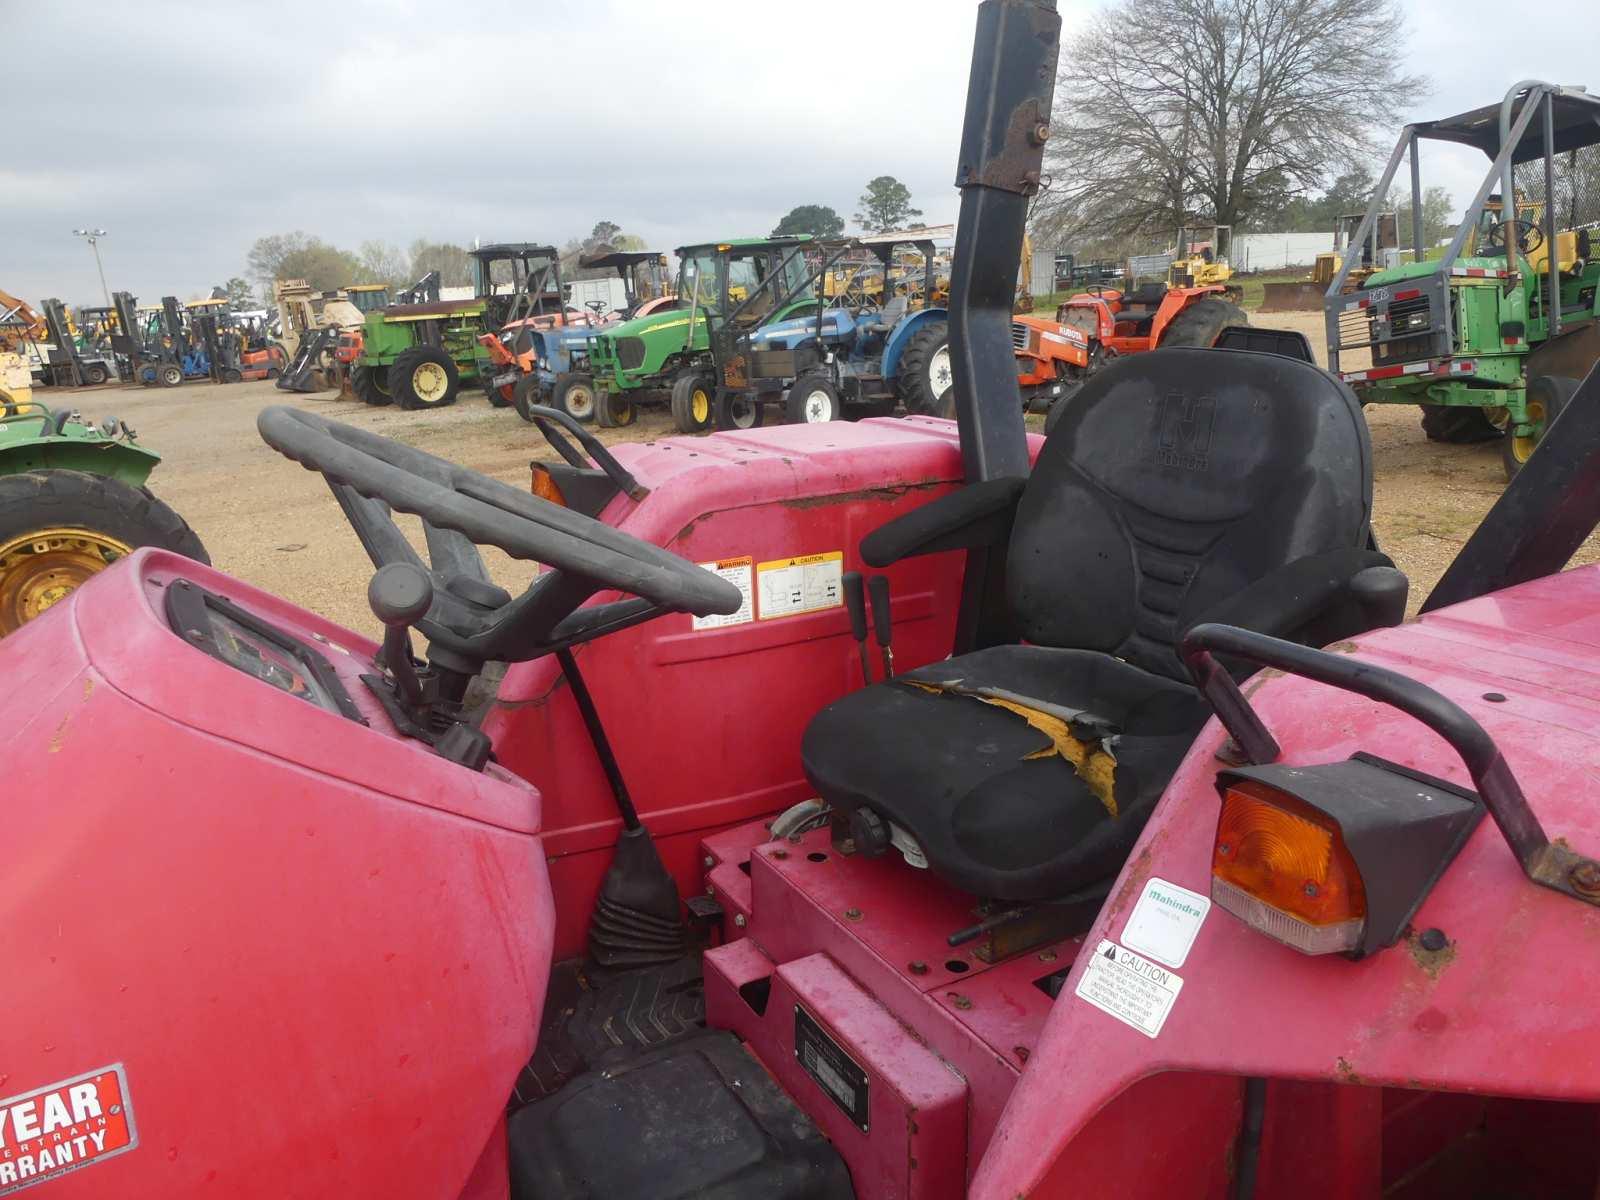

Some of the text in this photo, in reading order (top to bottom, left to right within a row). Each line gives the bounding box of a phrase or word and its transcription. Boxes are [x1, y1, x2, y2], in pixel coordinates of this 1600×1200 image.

[801, 555, 824, 564] CAUTION
[1149, 889, 1201, 918] Mahindra
[1121, 952, 1170, 985] CAUTION
